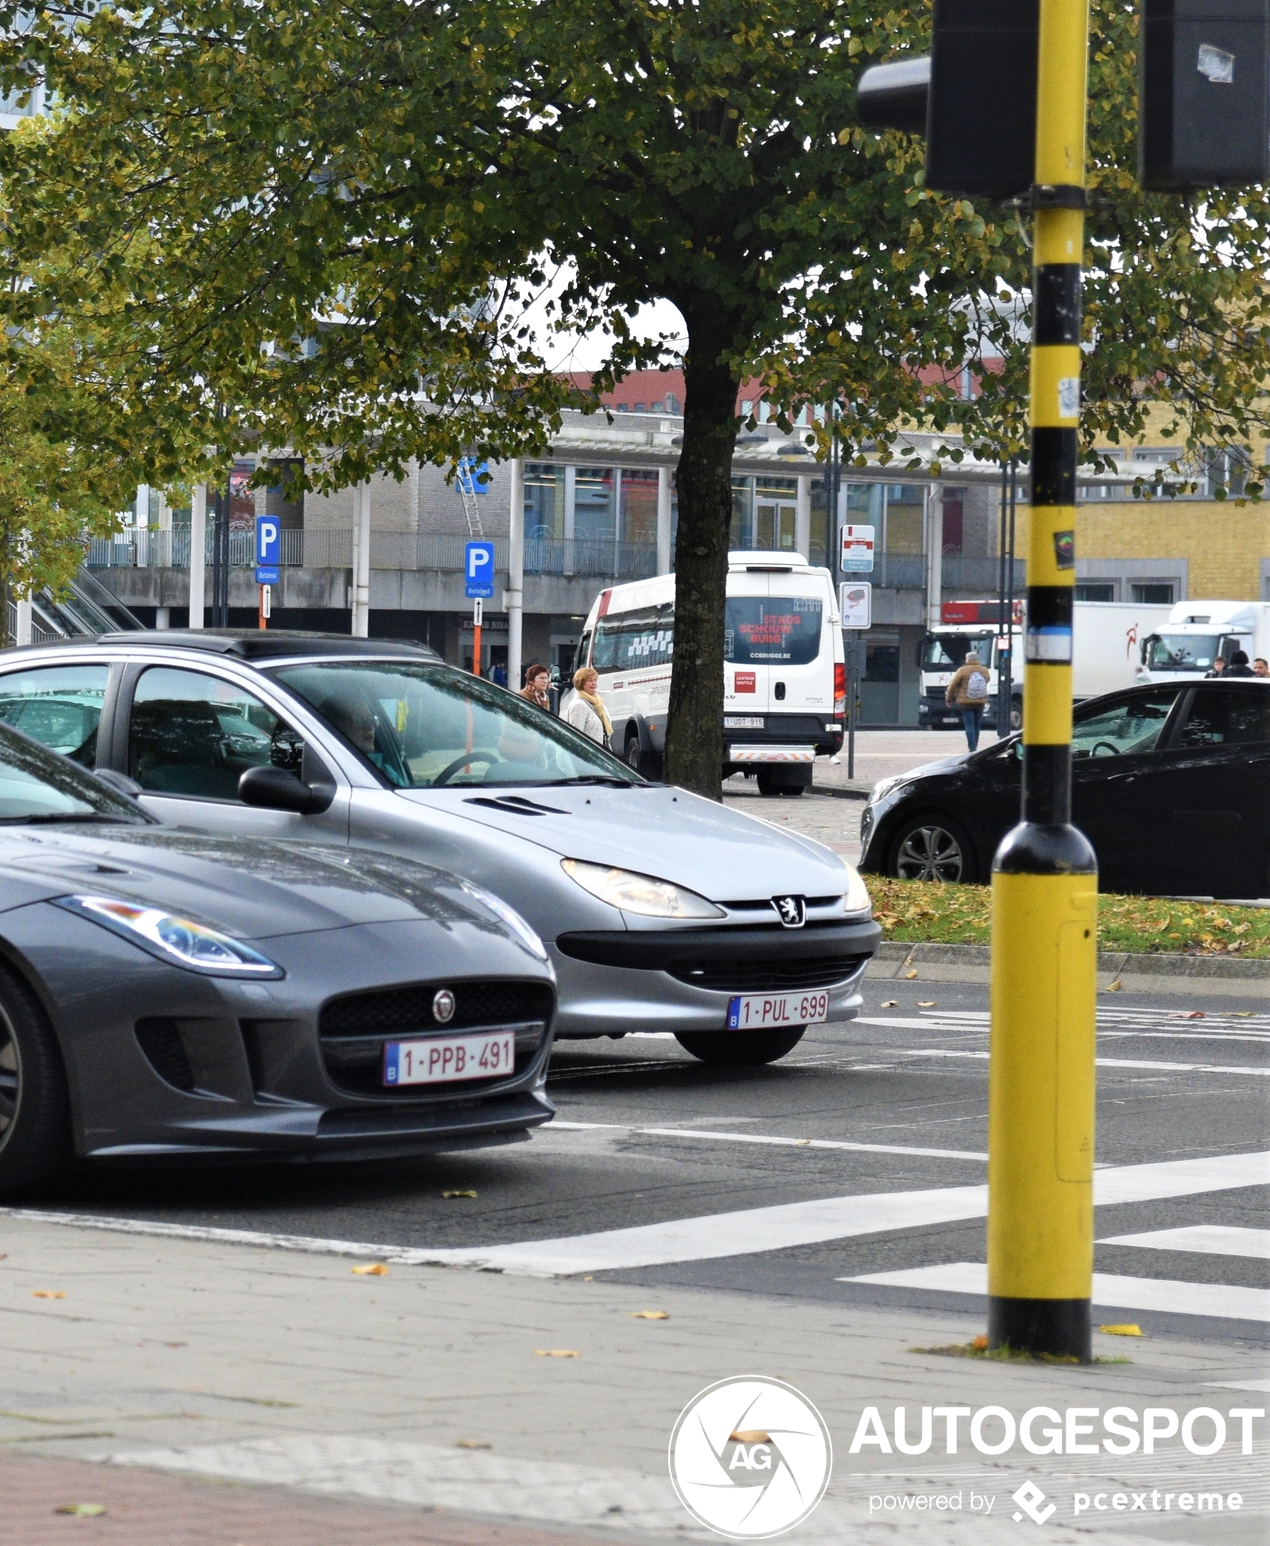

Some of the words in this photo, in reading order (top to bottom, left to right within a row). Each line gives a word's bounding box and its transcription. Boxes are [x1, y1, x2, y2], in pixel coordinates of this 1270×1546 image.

[261, 523, 277, 557] P
[469, 548, 489, 577] P
[463, 620, 489, 629] KEAB
[764, 615, 801, 625] STADS
[739, 624, 793, 634] SCHOUW
[750, 634, 782, 643] BURG
[730, 1016, 738, 1027] B
[387, 1067, 397, 1080] B
